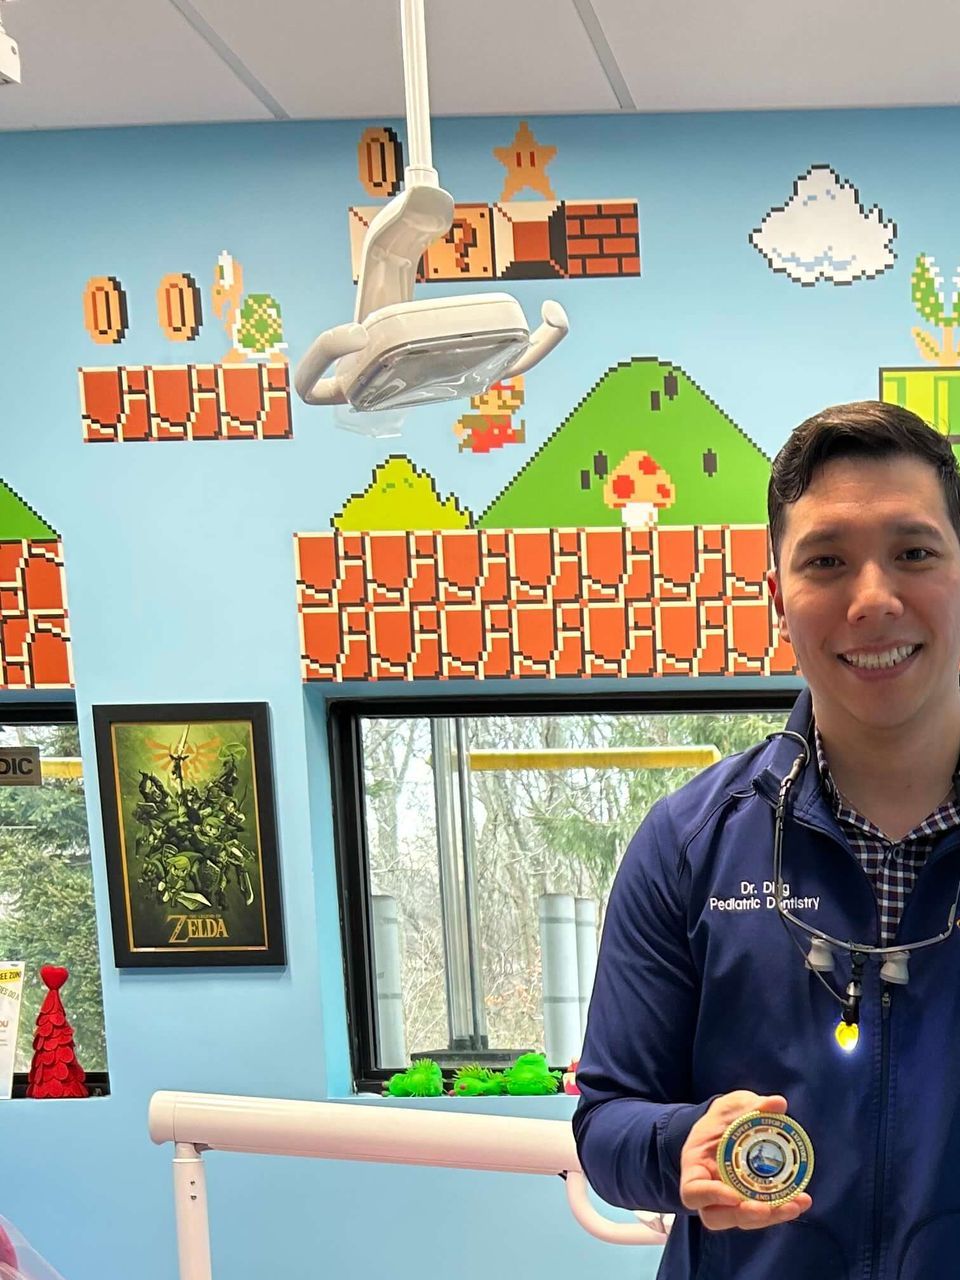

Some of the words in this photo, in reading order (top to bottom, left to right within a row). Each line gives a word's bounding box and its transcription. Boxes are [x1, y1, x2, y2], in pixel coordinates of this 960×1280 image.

[741, 881, 758, 894] Dr.
[763, 881, 790, 897] Dig
[709, 897, 761, 911] Pediatric
[766, 896, 820, 911] Dntistry
[166, 915, 230, 943] ZELDA
